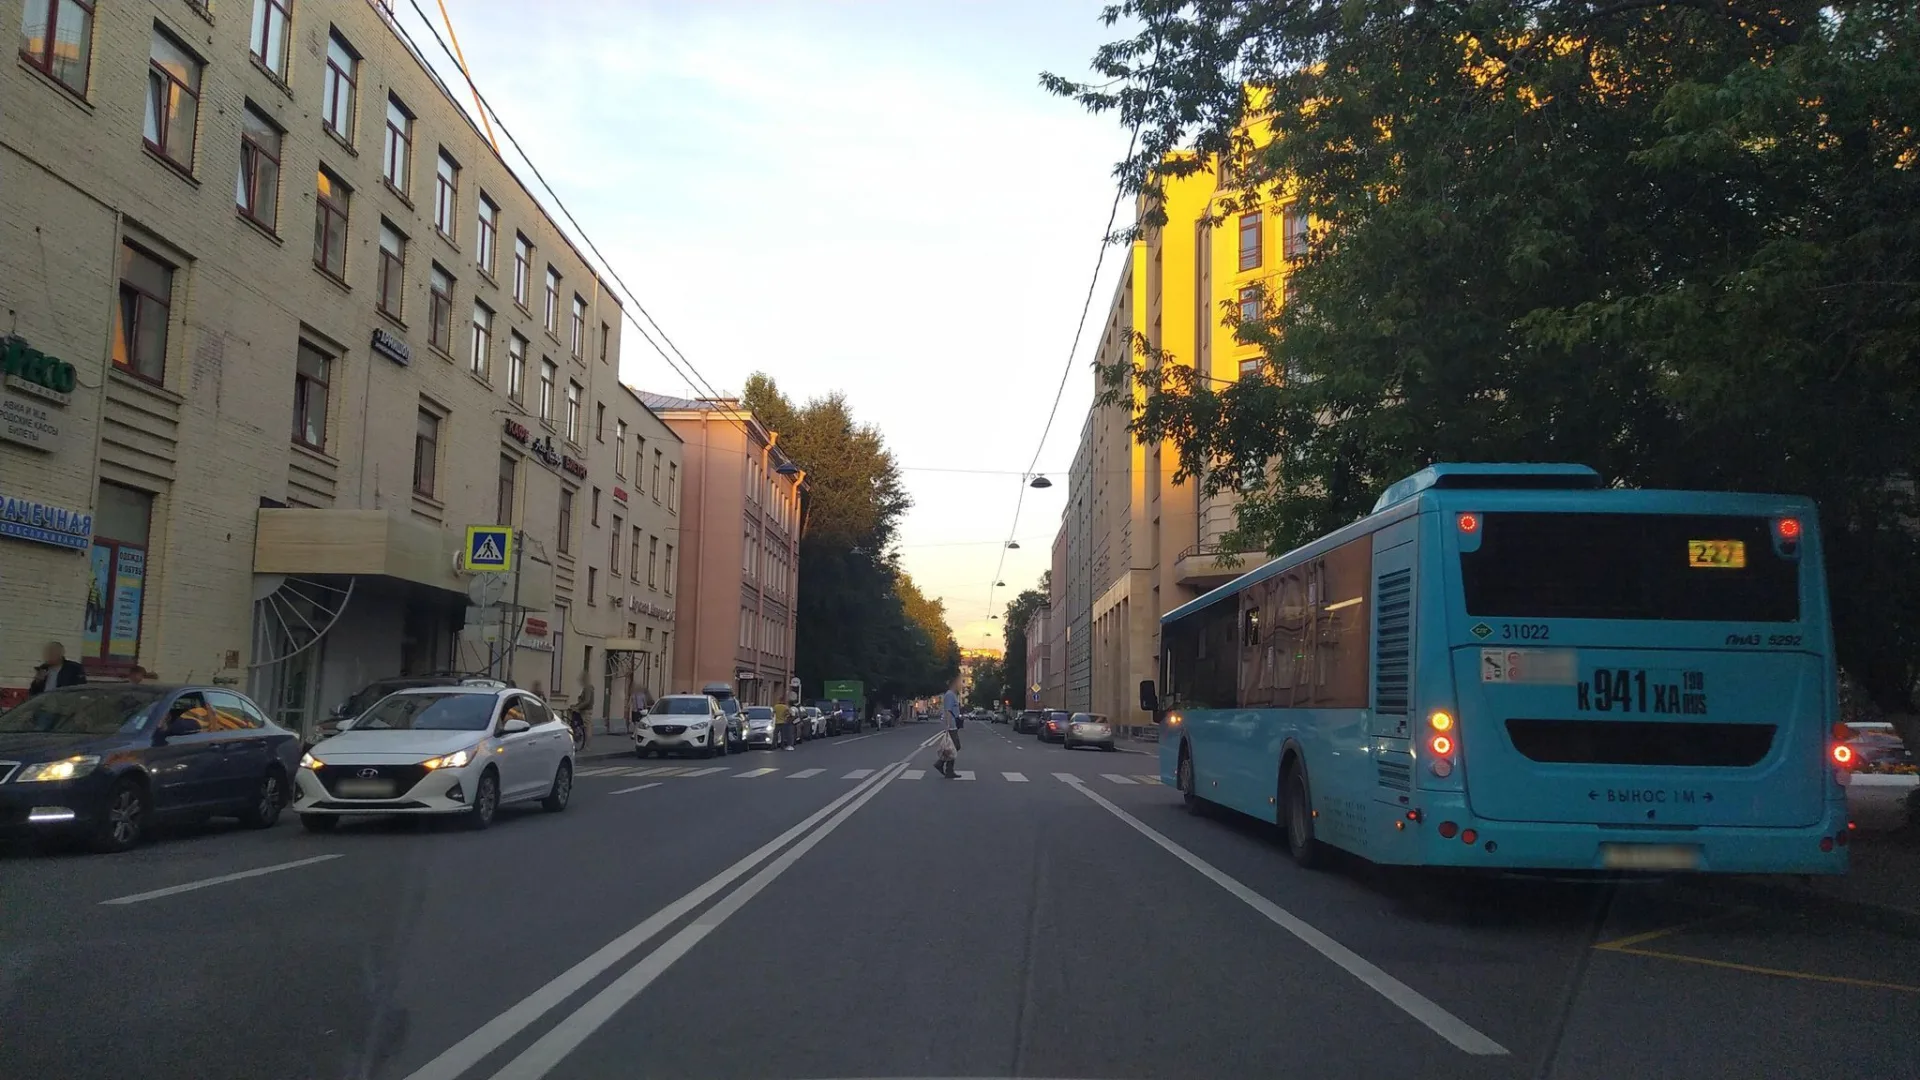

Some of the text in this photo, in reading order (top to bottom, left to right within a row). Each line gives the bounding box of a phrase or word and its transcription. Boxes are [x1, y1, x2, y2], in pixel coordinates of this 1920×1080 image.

[8, 424, 40, 441] БИЛЕТЫ
[1502, 623, 1549, 639] 31022
[1767, 634, 1802, 646] 5292
[1683, 693, 1707, 714] RUS
[1607, 789, 1667, 803] ВЫНОС
